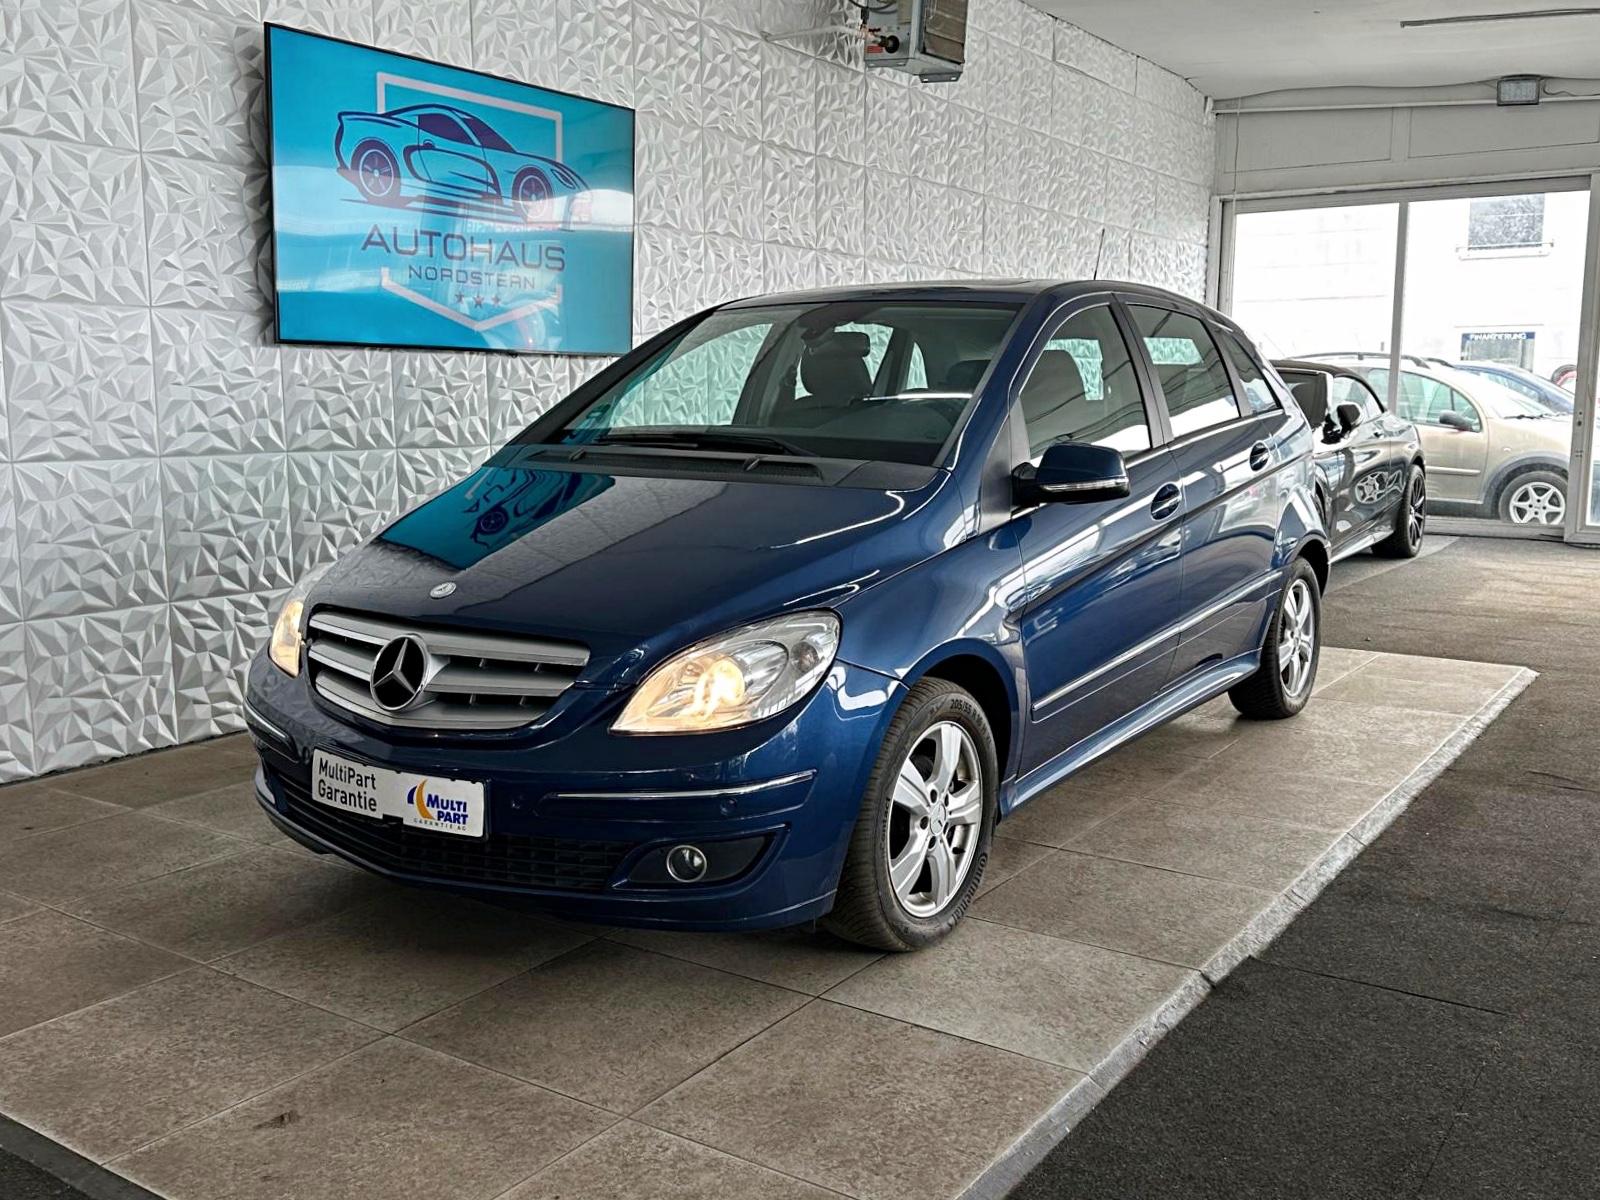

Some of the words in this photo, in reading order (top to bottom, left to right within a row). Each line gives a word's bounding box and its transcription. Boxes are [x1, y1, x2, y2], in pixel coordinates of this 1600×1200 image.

[361, 223, 565, 272] AUTOHAUS
[408, 264, 536, 290] NORDSTERN
[319, 757, 377, 790] MultiPart
[318, 779, 377, 811] Garantie
[413, 818, 453, 829] GARANTIE
[437, 810, 469, 825] PART
[952, 852, 988, 926] Continental
